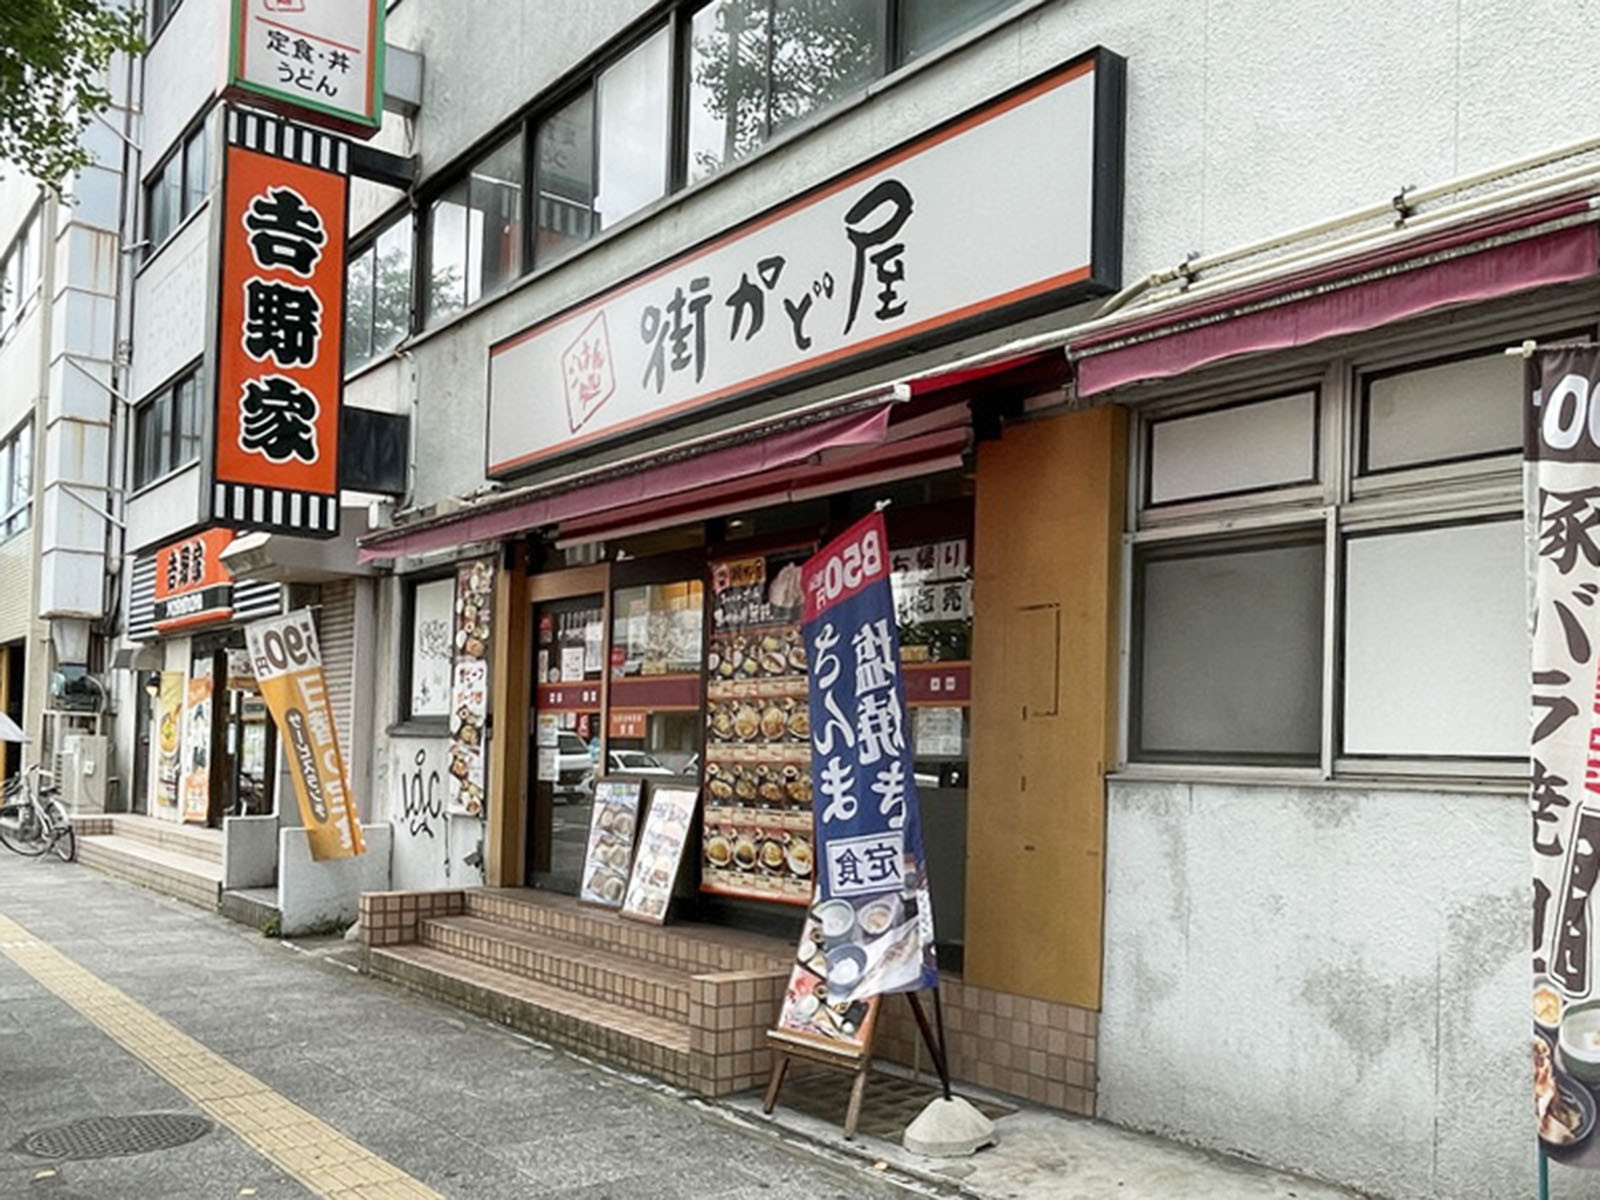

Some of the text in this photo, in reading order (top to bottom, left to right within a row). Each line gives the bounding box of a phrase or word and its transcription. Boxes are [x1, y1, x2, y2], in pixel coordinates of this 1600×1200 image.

[277, 61, 338, 97] うどん
[241, 187, 326, 464] 吉野家
[641, 178, 915, 394] 街かど屋
